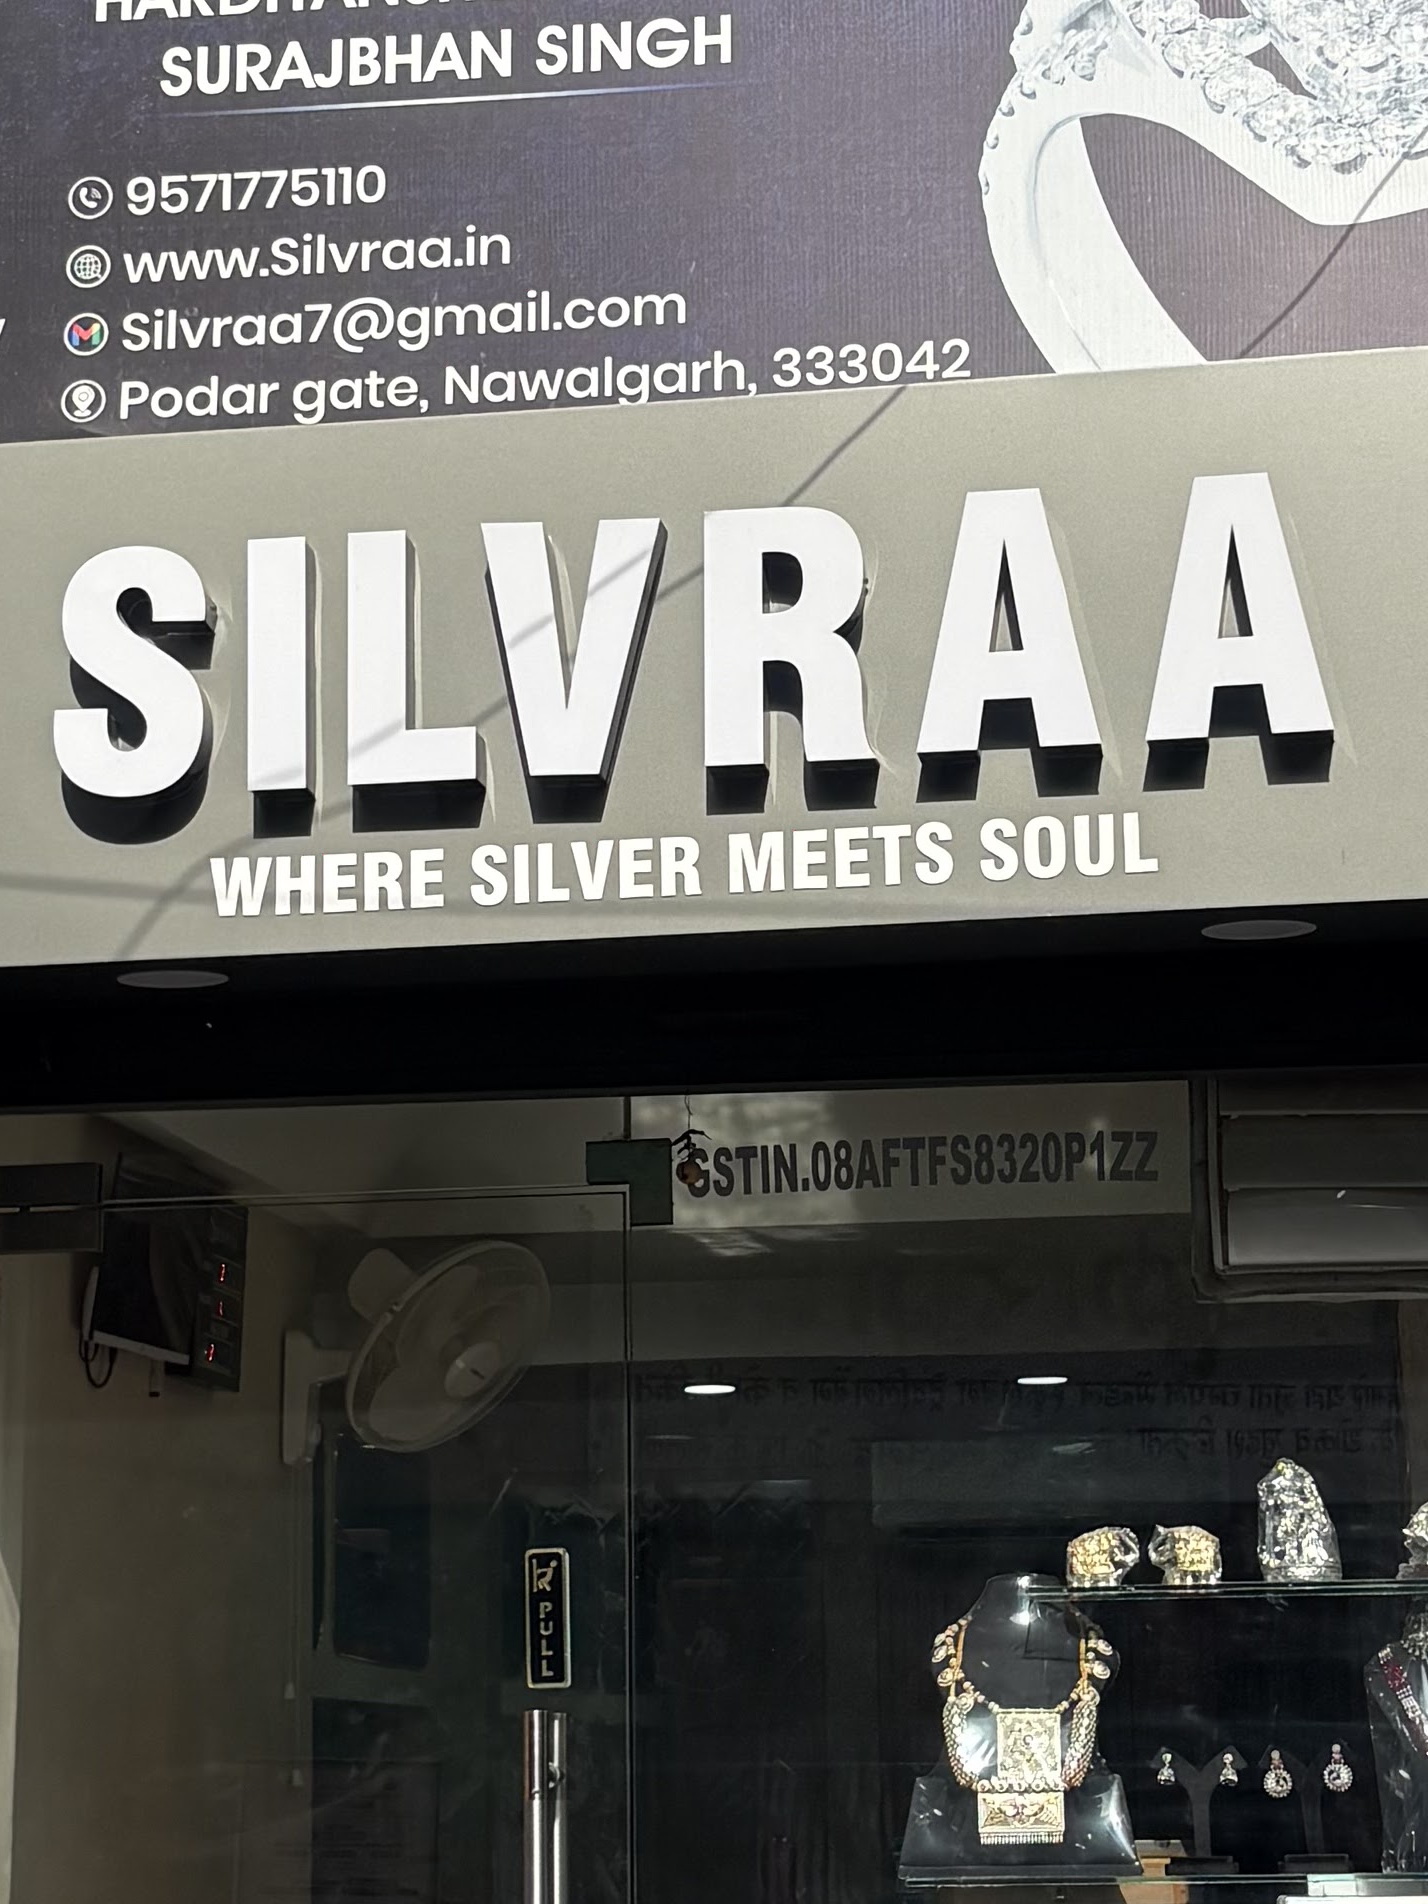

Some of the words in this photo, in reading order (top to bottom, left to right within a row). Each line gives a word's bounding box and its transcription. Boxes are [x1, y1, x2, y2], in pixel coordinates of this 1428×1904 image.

[158, 25, 514, 100] SURAJBHAN
[535, 13, 734, 77] SINGH
[124, 164, 387, 216] 9571775110
[122, 224, 512, 285] www.Silvraa.in
[121, 287, 688, 352] Silvraa7@gmail.com
[118, 375, 279, 421] Podar
[291, 369, 430, 426] gate,
[443, 346, 760, 408] Nawalgarh,
[771, 336, 972, 388] 333042
[52, 471, 1336, 831] SILVRAA
[209, 848, 446, 918] WHERE
[468, 832, 703, 909] SILVER
[727, 820, 955, 893] MEETS
[978, 811, 1160, 879] SOUL
[539, 1601, 554, 1677] PULL
